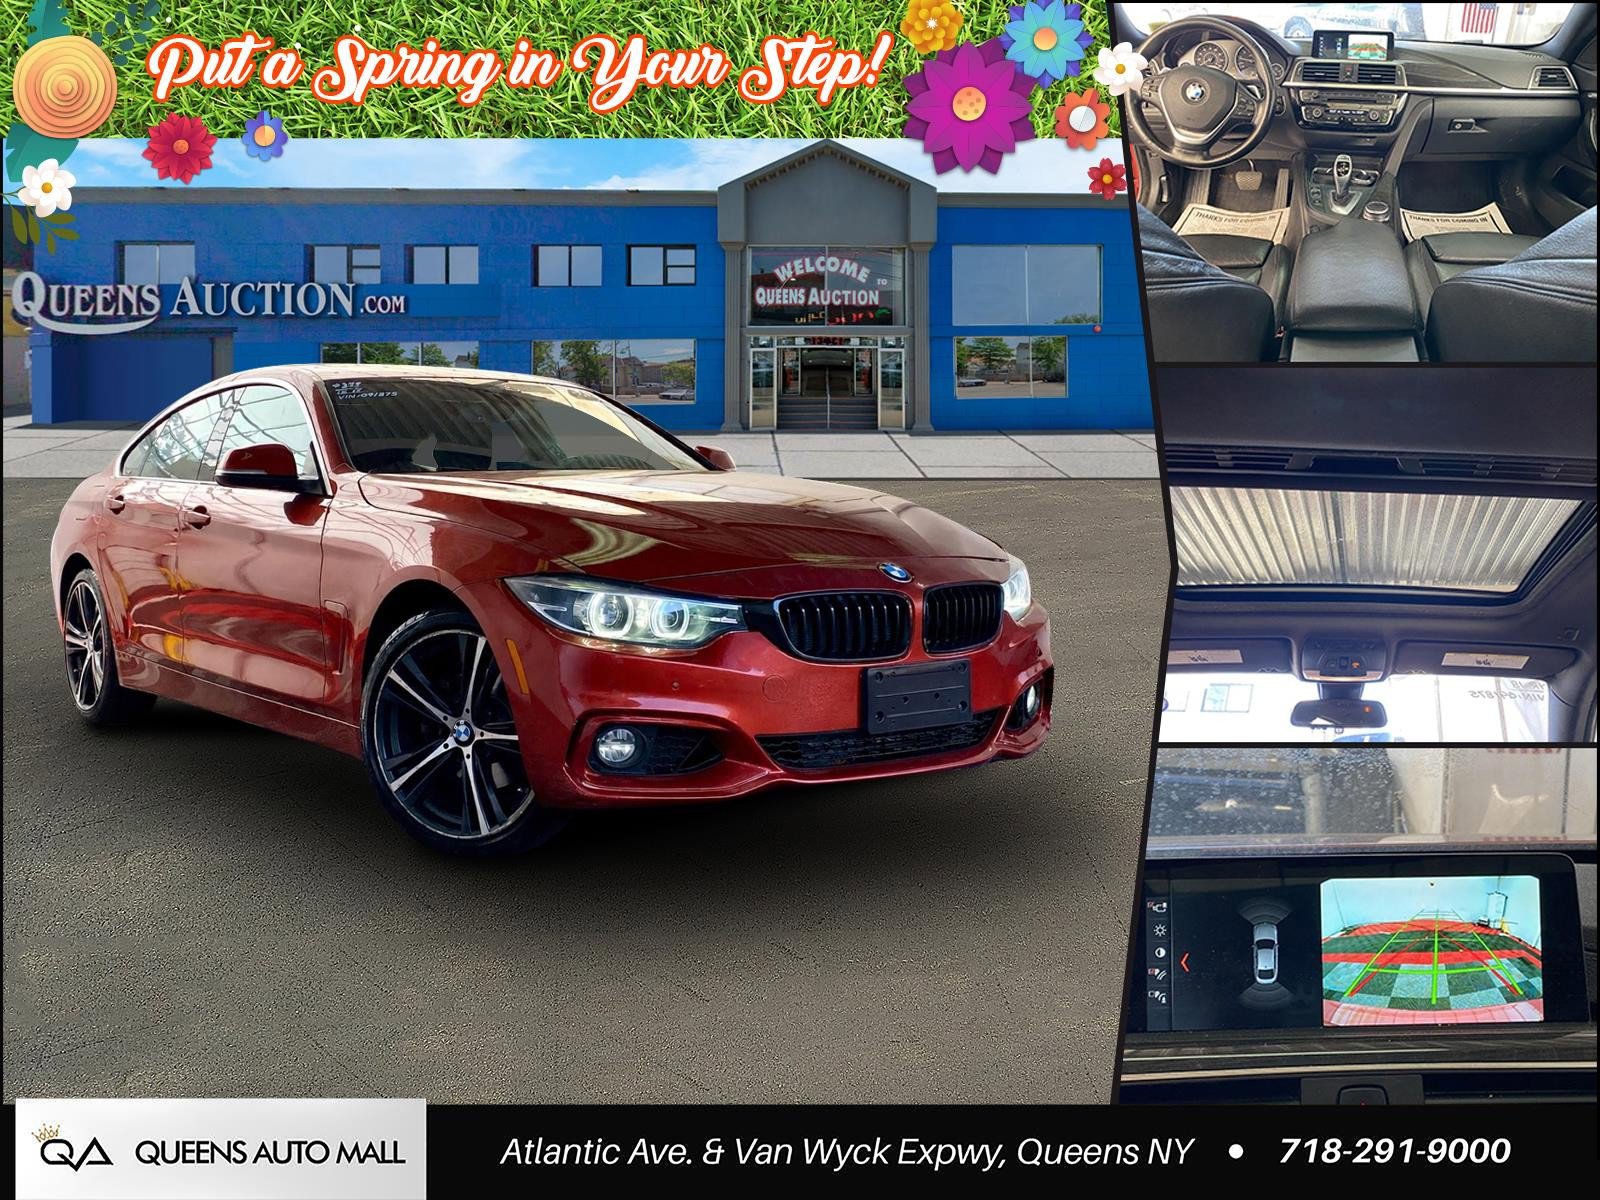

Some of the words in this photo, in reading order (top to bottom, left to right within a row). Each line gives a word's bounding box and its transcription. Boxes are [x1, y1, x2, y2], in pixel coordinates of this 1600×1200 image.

[774, 256, 871, 284] WELCOME
[876, 278, 888, 286] TO
[12, 271, 161, 335] QUEENS
[170, 276, 356, 317] AUCTION
[755, 287, 806, 307] QUEENS
[807, 287, 880, 307] AUCTION
